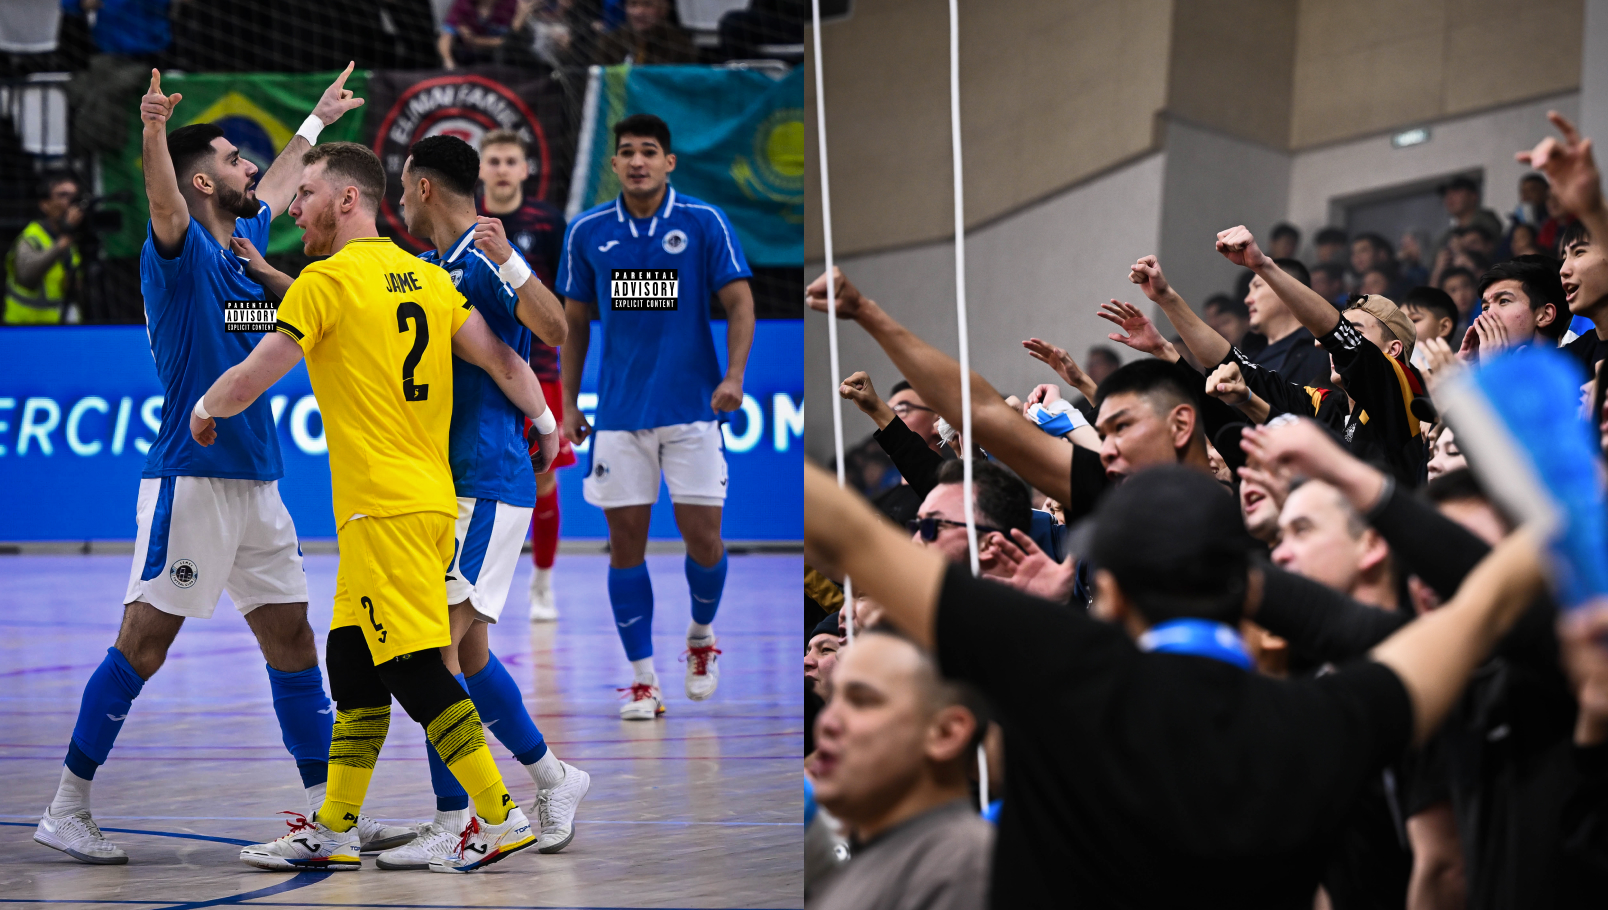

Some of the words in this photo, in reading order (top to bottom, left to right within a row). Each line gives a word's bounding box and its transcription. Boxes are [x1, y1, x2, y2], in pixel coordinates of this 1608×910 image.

[384, 271, 423, 293] JAME
[396, 301, 430, 402] 2
[361, 595, 384, 632] 2
